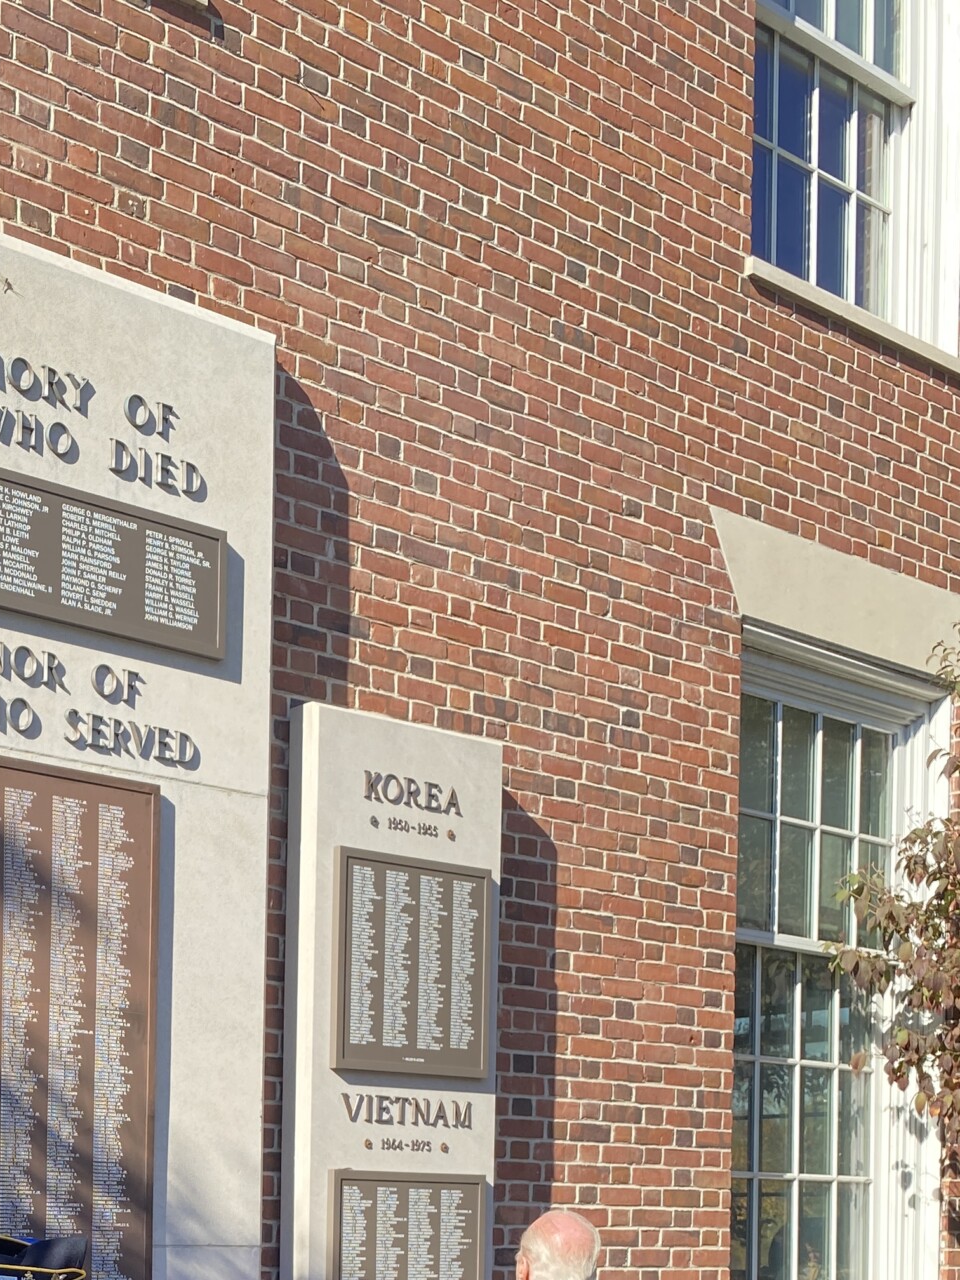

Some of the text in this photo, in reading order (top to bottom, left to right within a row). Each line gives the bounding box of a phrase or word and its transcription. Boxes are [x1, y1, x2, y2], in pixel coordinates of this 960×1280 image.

[124, 394, 173, 433] OF
[109, 438, 202, 493] DIED
[91, 663, 140, 702] OF
[64, 708, 195, 763] SERVED
[364, 769, 463, 818] KOREA
[341, 1092, 473, 1130] VIETNAM
